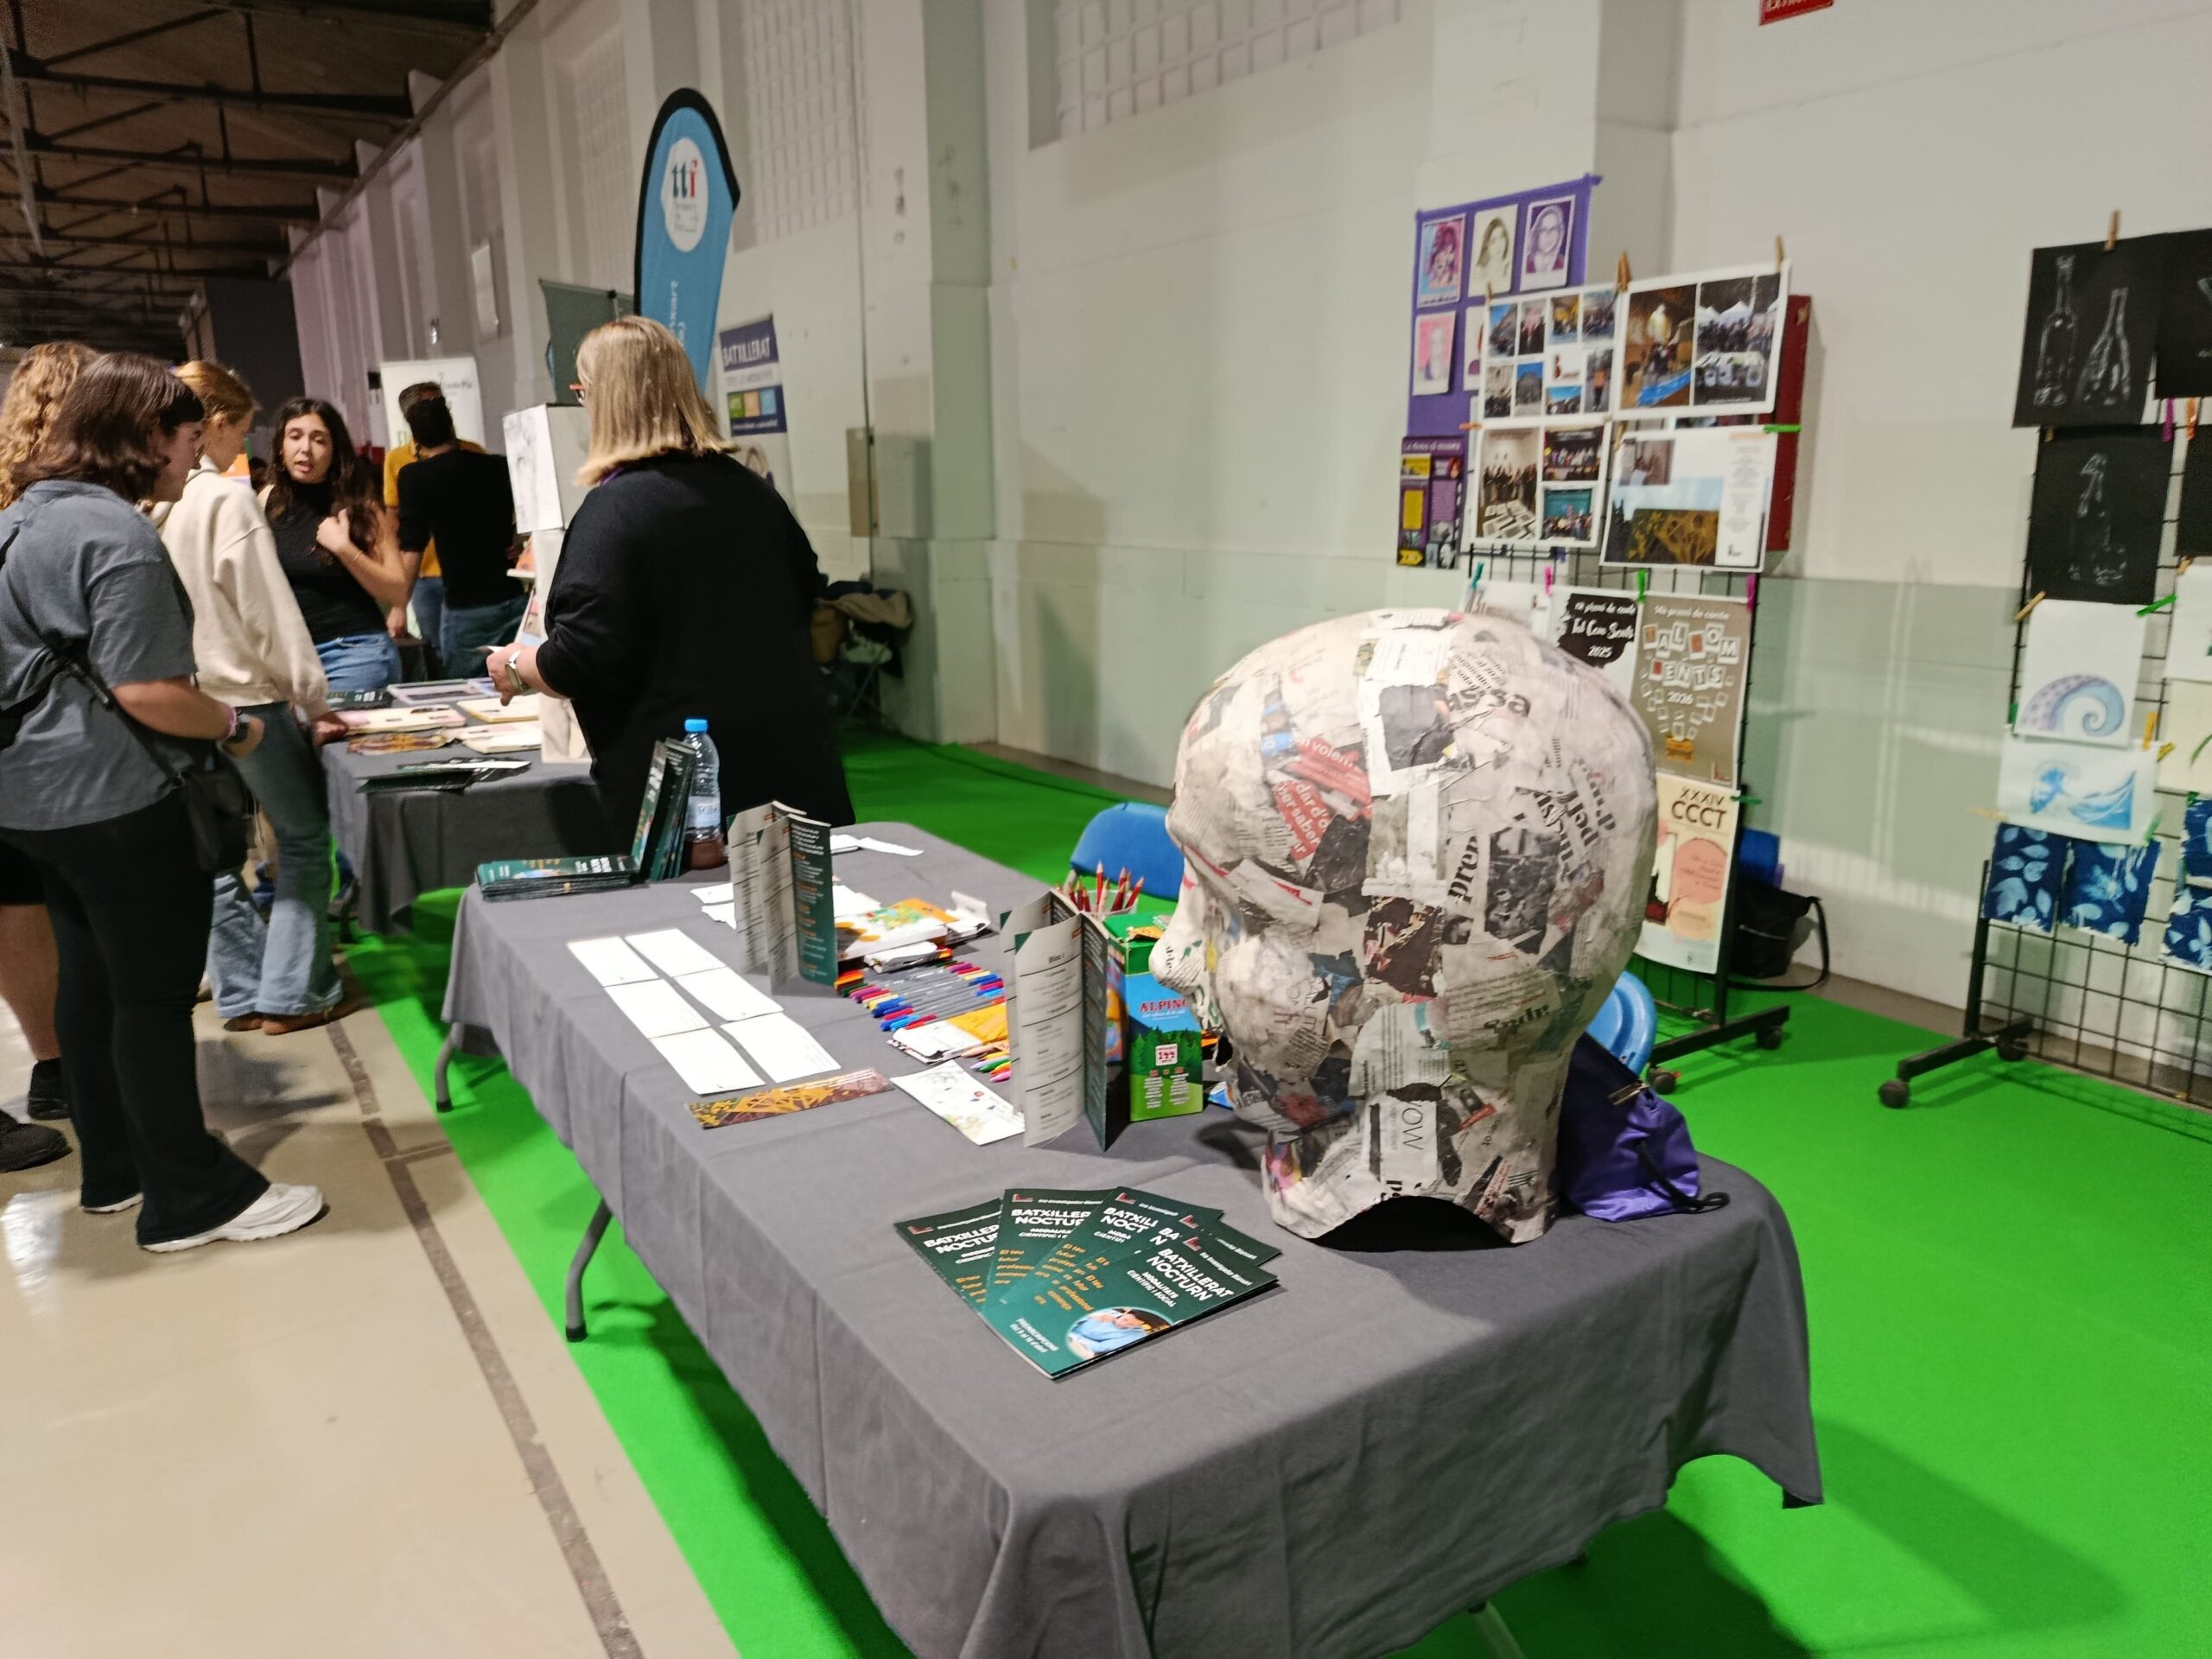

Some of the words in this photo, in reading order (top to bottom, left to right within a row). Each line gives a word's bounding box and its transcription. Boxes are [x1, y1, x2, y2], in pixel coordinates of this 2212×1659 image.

[722, 336, 771, 367] BATXILLERAT
[1667, 690, 1694, 704] 2026
[1680, 787, 1725, 805] XXXIV
[1671, 800, 1727, 830] CCCT
[1140, 997, 1189, 1012] ALPIN
[1402, 1102, 1424, 1150] OW
[1146, 1255, 1213, 1301] NOCTURN
[1158, 1248, 1234, 1298] BATXILLERAT
